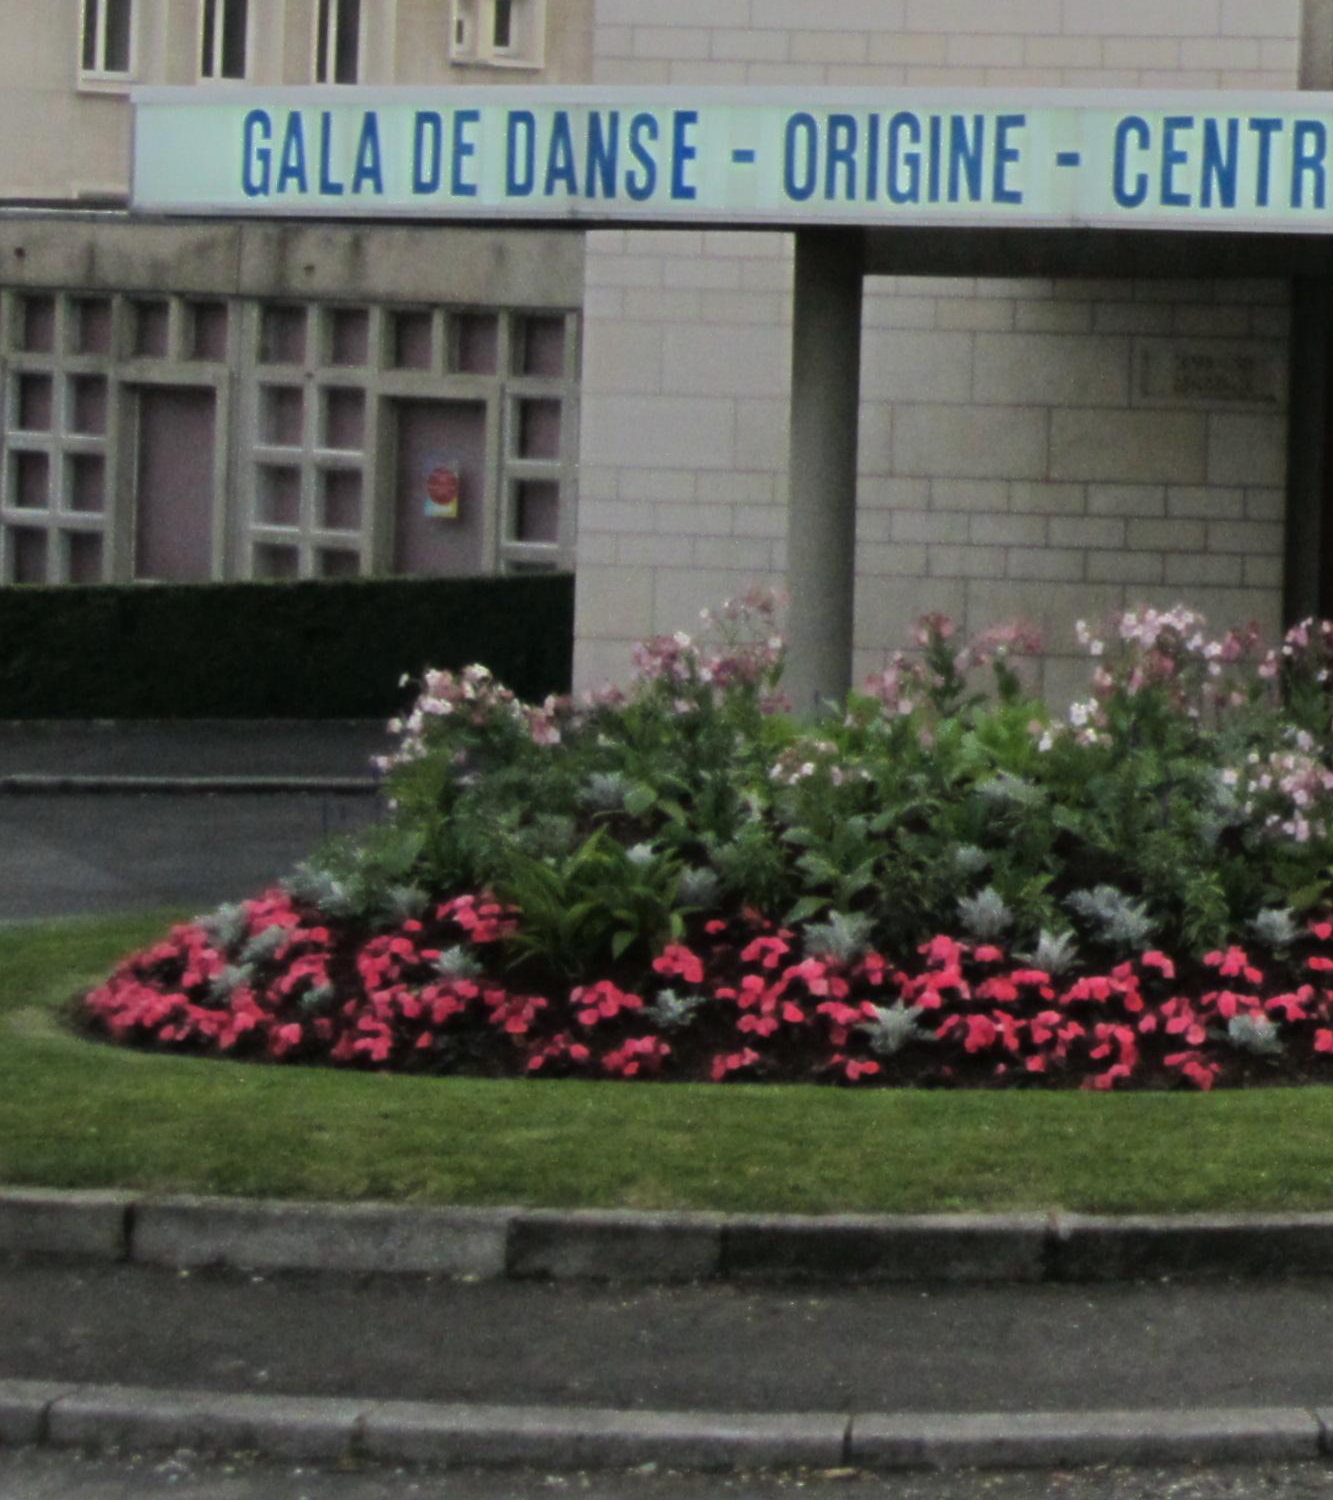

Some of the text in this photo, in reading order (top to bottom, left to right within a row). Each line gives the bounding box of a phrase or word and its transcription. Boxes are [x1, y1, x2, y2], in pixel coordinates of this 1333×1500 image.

[242, 108, 386, 198] GALA
[412, 108, 482, 197] DE
[505, 109, 701, 202] DANSE
[785, 112, 1027, 204] ORIGINE
